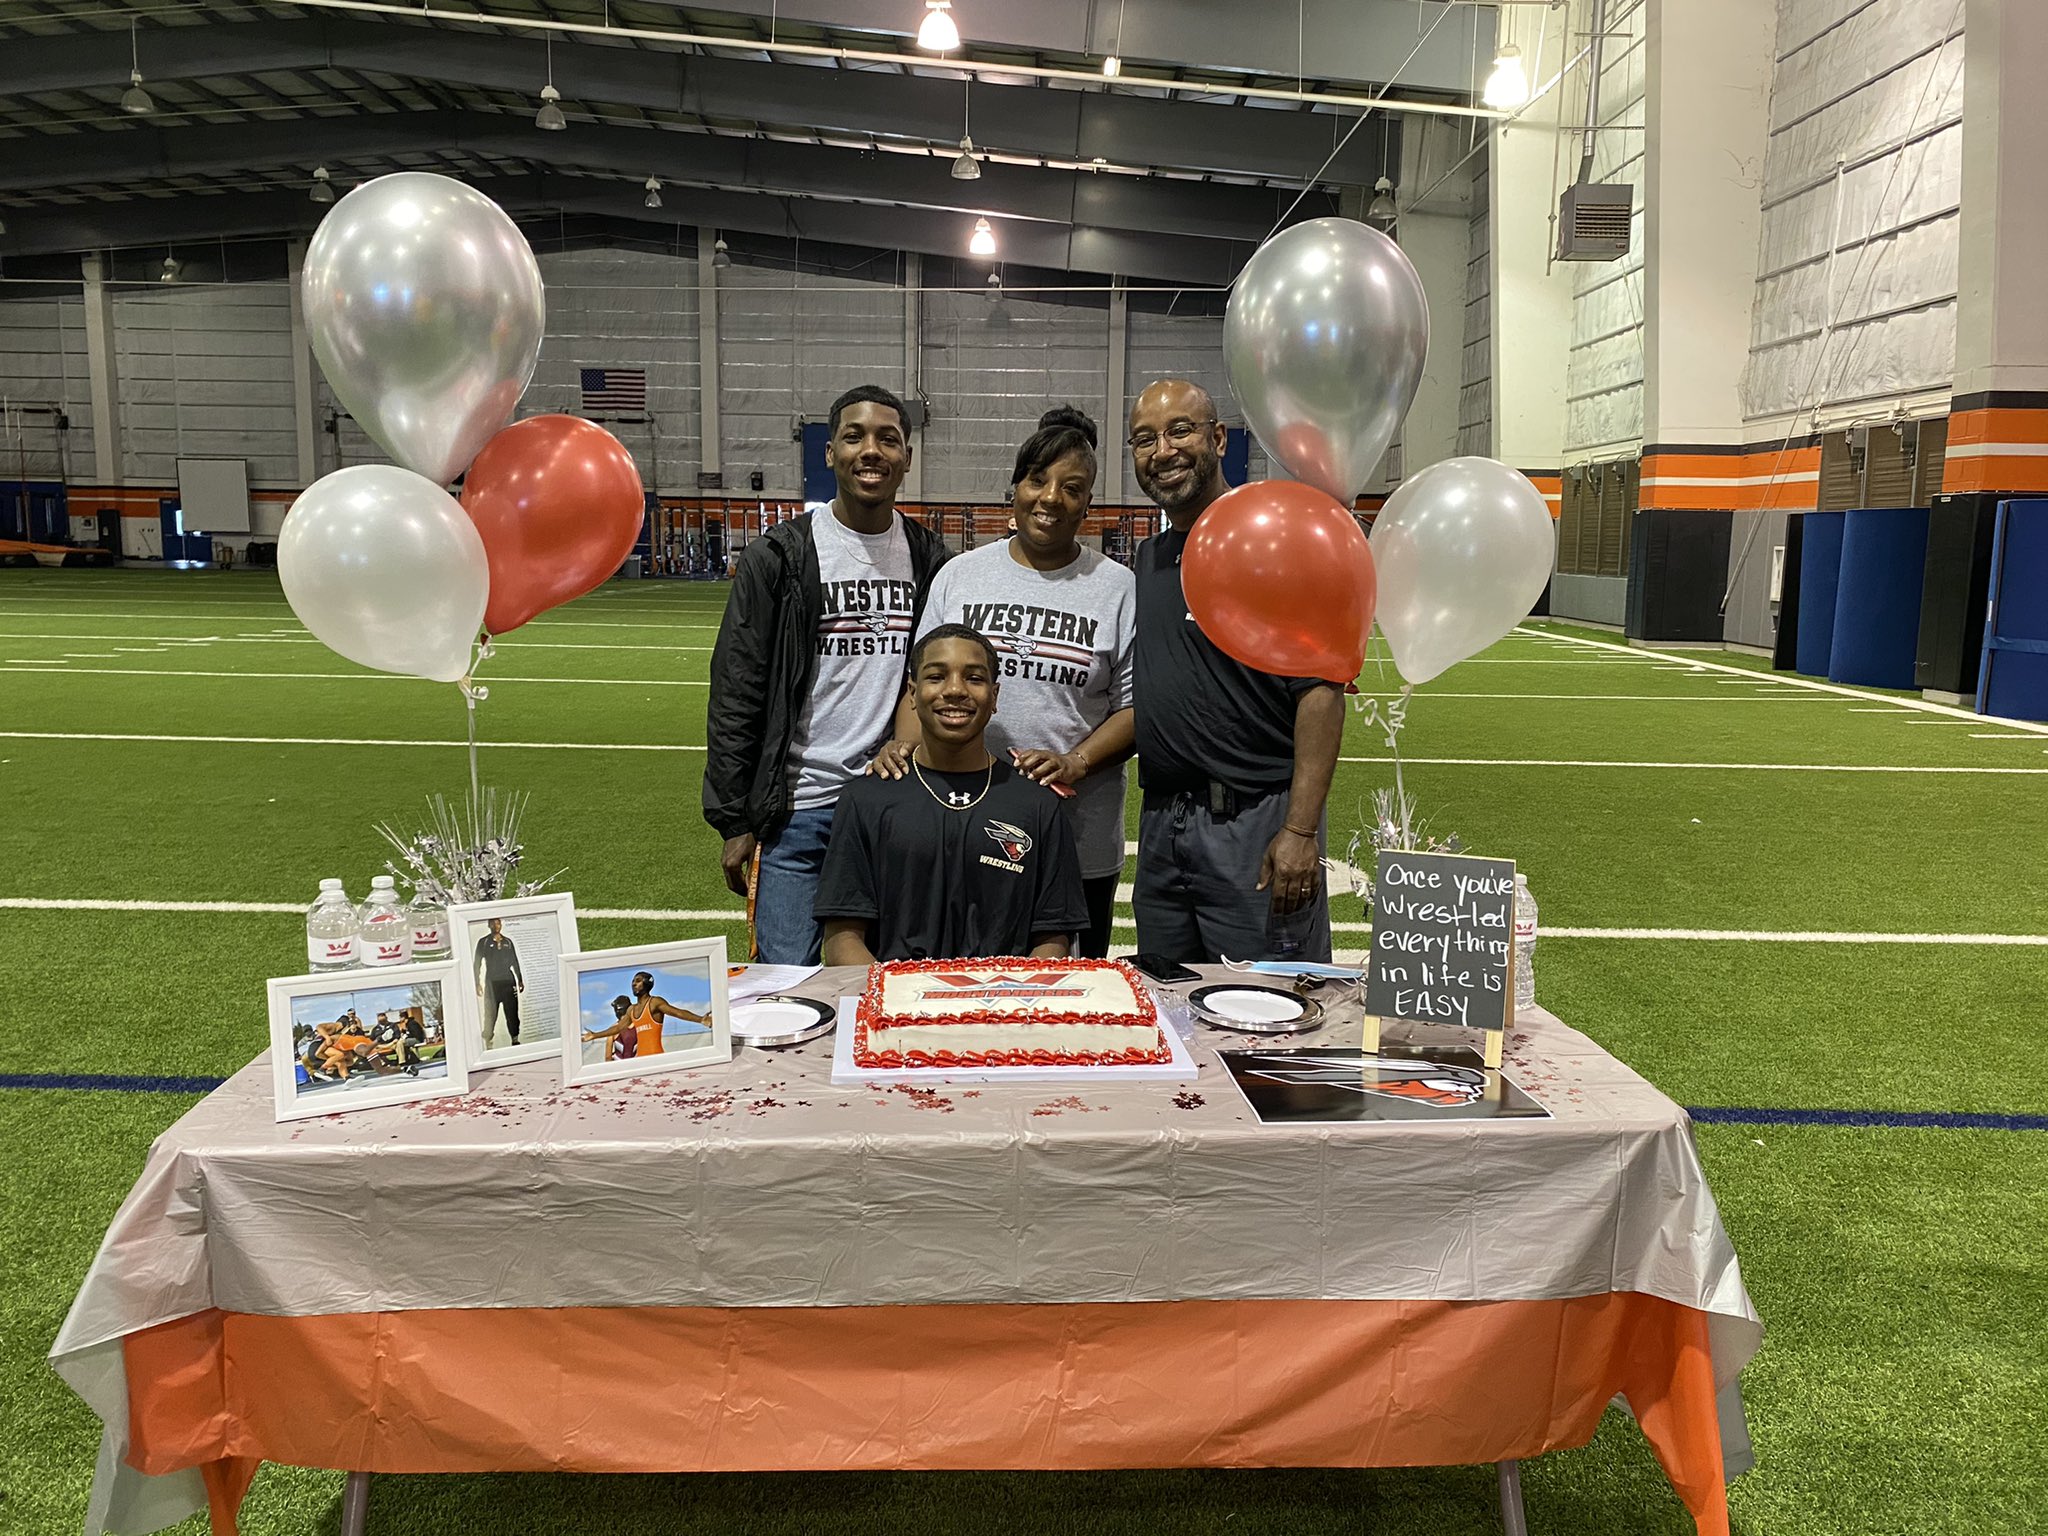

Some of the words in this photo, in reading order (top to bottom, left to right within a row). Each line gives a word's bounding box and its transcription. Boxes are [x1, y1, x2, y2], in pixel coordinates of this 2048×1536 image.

[820, 579, 916, 615] WESTER
[962, 603, 1099, 648] WESTERN
[816, 636, 908, 656] WRESTLI
[998, 657, 1089, 688] STLING
[979, 854, 1024, 874] WRESTLING
[1385, 863, 1442, 888] Once
[1453, 869, 1514, 906] you've
[1381, 962, 1408, 982] in
[1421, 962, 1475, 988] life
[1482, 968, 1502, 992] is
[922, 989, 1088, 1000] MOUNTAINEERS
[1395, 988, 1469, 1026] EASY
